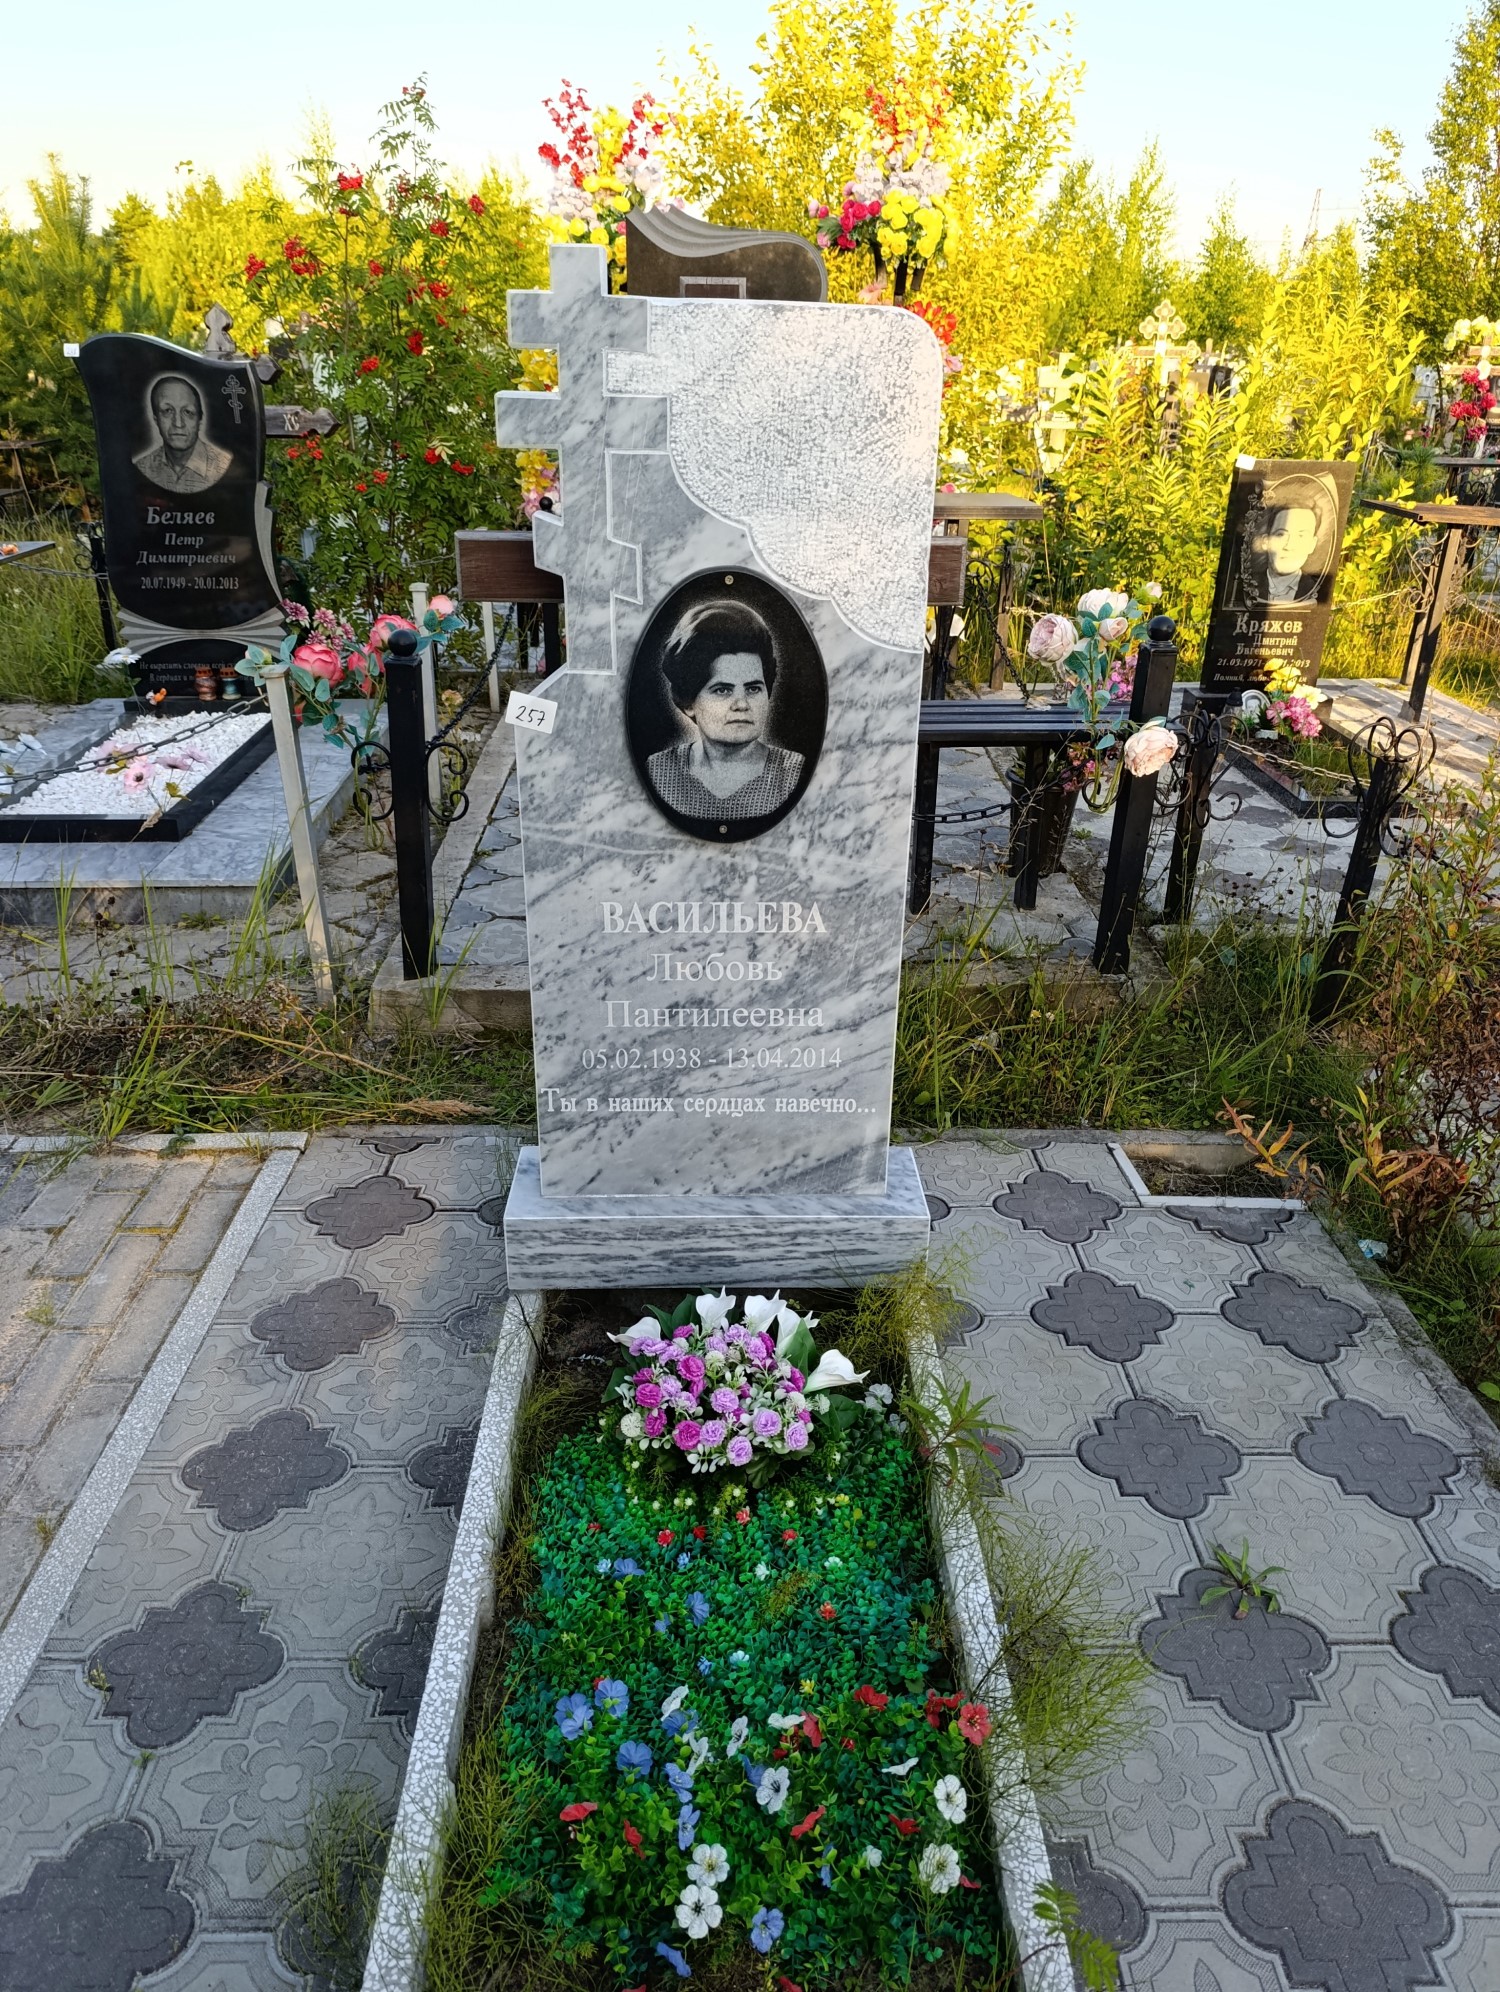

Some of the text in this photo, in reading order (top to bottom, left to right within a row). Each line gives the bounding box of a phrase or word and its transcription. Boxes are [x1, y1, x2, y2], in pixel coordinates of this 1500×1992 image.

[146, 506, 216, 525] Беляев
[164, 533, 204, 548] Петр
[136, 551, 236, 567] Димитриевич
[140, 576, 186, 590] 20.07.1949
[194, 576, 240, 590] 20.01.2013
[1232, 612, 1303, 636] Кряжев
[1235, 643, 1294, 656] Евгеньевич
[1253, 633, 1298, 648] Дмитрий
[515, 705, 546, 727] 257
[600, 901, 827, 934] ВАСИЛЬЕВА
[646, 951, 783, 982] Любовь
[604, 1000, 826, 1028] Пантилеевна
[581, 1048, 701, 1070] 05.02.1938
[726, 1047, 843, 1068] 13.04.2014
[540, 1087, 877, 1117] Ты в наших сердцах навечно...
